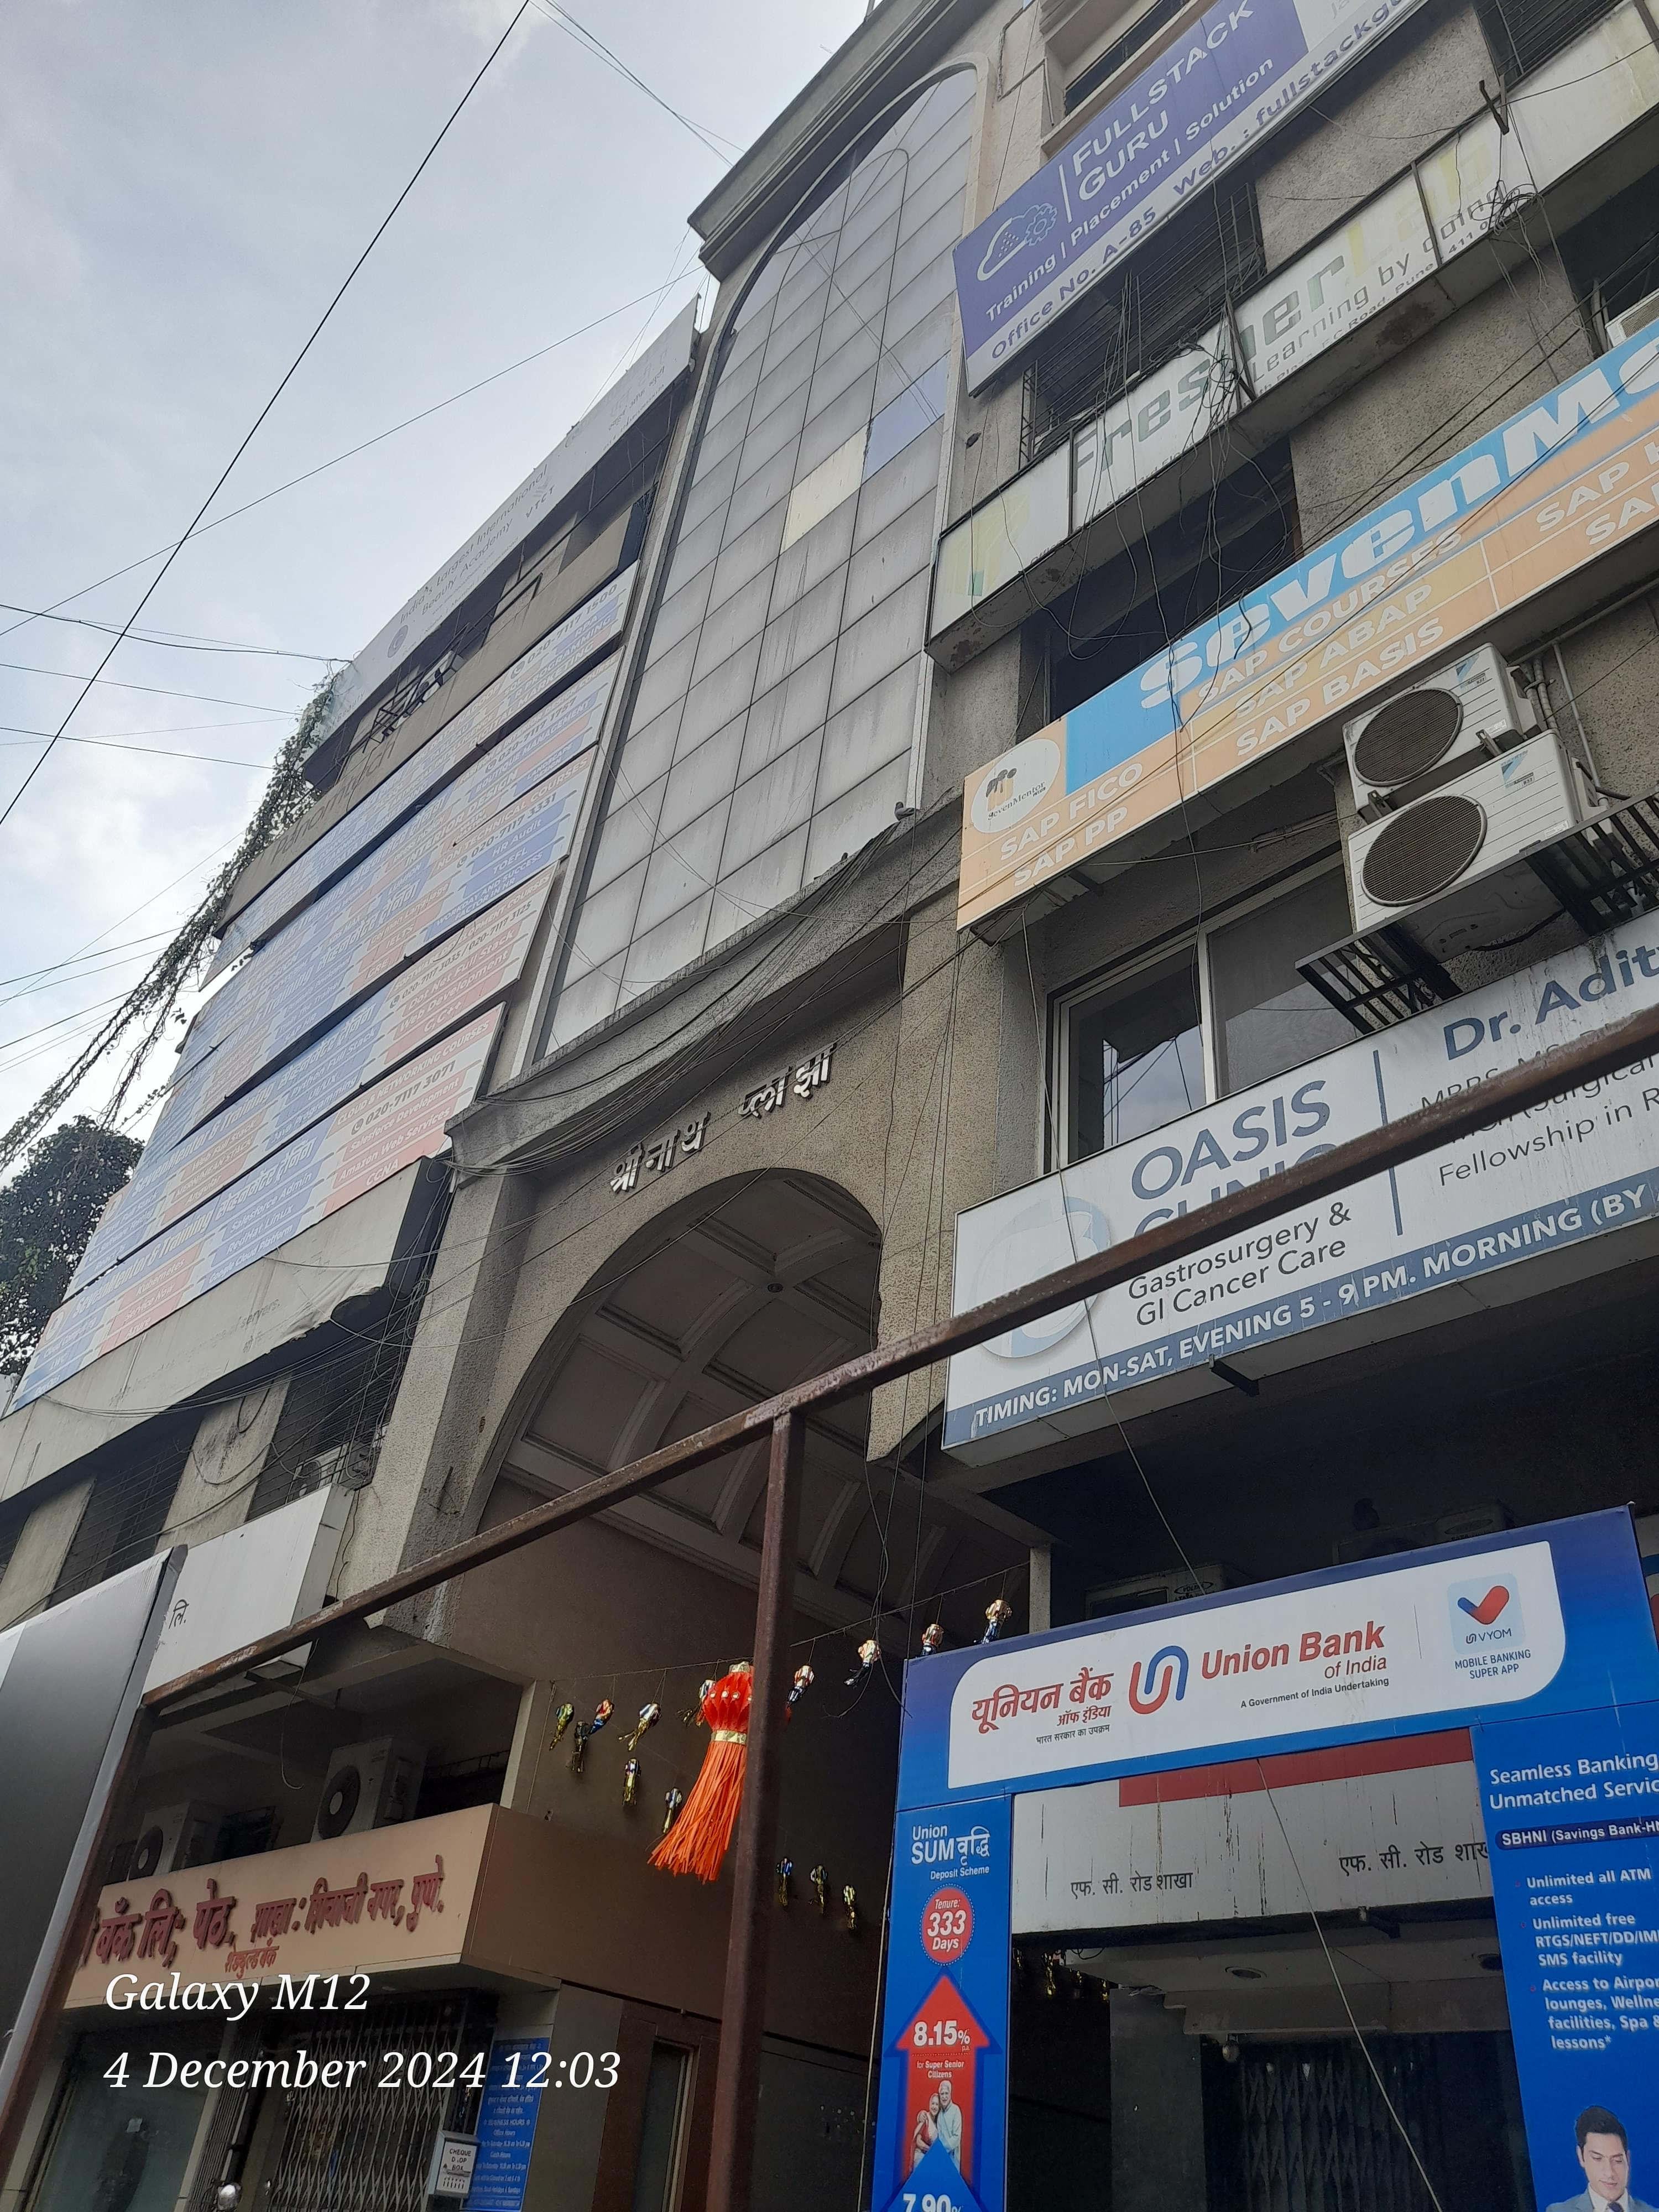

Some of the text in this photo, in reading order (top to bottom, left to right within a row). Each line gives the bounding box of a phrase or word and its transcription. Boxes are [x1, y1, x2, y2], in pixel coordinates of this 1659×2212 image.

[1071, 0, 1256, 176] FULLSTACK
[1079, 109, 1170, 201] GURU
[985, 58, 1274, 323] Training Placement Solution
[990, 298, 1055, 360] Office
[1058, 263, 1097, 302] No.
[1102, 207, 1157, 264] A-85
[1173, 143, 1235, 197] Web.
[1253, 253, 1411, 382] Learning by
[1537, 462, 1629, 532] SAP
[1585, 481, 1659, 545] SA
[437, 540, 473, 588] Largest
[479, 465, 545, 543] International
[422, 514, 511, 615] Beauty Academy
[526, 578, 619, 668] 020-7117 1500
[1198, 525, 1463, 703] SAP COURSES
[1235, 583, 1432, 718] SAP ABAP
[515, 635, 594, 713] MARKETING
[1237, 618, 1444, 757] SAP BASIS
[405, 769, 517, 865] INTERIOR DESIGN
[436, 755, 587, 870] NON TECHNICAL COURSES
[471, 790, 557, 858] 020-7117 3331
[1000, 763, 1143, 860] SAP FICO
[490, 815, 542, 859] HR Audit
[1014, 806, 1128, 886] SAP PP
[491, 842, 529, 878] TOEFL
[478, 927, 514, 961] Stack
[398, 948, 507, 1034] Web Development
[1443, 943, 1659, 1061] Dr. Adit
[336, 1017, 489, 1126] CLOUD NETWORKING COURSES
[365, 1057, 456, 1126] 020-7117 3071
[349, 1075, 458, 1154] Salesforce Development
[338, 1103, 450, 1182] Amazon Web Services
[1132, 1079, 1331, 1201] OASIS
[1438, 1117, 1595, 1186] Fellowship
[1604, 1104, 1632, 1125] in
[279, 1170, 312, 1199] Admin
[365, 1156, 399, 1187] CCNA
[1129, 1201, 1352, 1300] Gastrosurgery &
[1136, 1239, 1347, 1326] GI Cancer Care
[975, 1184, 1647, 1427] TIMING: MON-SAT, EVENING 5 9 PM. MORNING (BY
[1201, 1620, 1386, 1680] Union Bank
[1478, 1627, 1512, 1643] VYOM
[1324, 1655, 1387, 1679] of India
[1454, 1648, 1532, 1670] MOBILE BANKING
[1468, 1662, 1520, 1680] SUPER APP
[972, 1667, 1115, 1735] यूनियन बैंक
[1240, 1677, 1390, 1709] A Government of India Undertaking
[1036, 1723, 1111, 1745] भारत सरकार का उपक्रम
[1057, 1704, 1113, 1727] ऑफ इंडिया
[1490, 1752, 1659, 1785] Seamless Banking
[1489, 1783, 1598, 1810] Unmatched
[912, 1824, 948, 1841] Union
[1501, 1827, 1606, 1846] SBHNI (Savings
[930, 1865, 990, 1881] Deposit Scheme
[1339, 1840, 1444, 1877] एफ. सी. रोड
[1527, 1868, 1652, 1890] Unlimited all ATM
[935, 1898, 961, 1910] Tenure:
[1071, 1870, 1194, 1898] एफ. सी. रोड शाखा
[1529, 1892, 1574, 1906] access
[927, 1910, 967, 1937] 333
[1532, 1912, 1636, 1931] Unlimited free
[1535, 1929, 1659, 1949] RTGS/NEFT/DD/IM
[932, 1937, 960, 1952] Days
[1538, 1950, 1623, 1968] SMS facility
[1542, 1978, 1589, 1992] Access
[1593, 1976, 1609, 1990] to
[1545, 1996, 1607, 2014] lounges,
[914, 2020, 971, 2046] 8.15%
[1548, 2015, 1649, 2033] facilities, Spa
[925, 2060, 943, 2070] Super
[945, 2059, 965, 2068] Senior
[928, 2070, 952, 2079] Citizens
